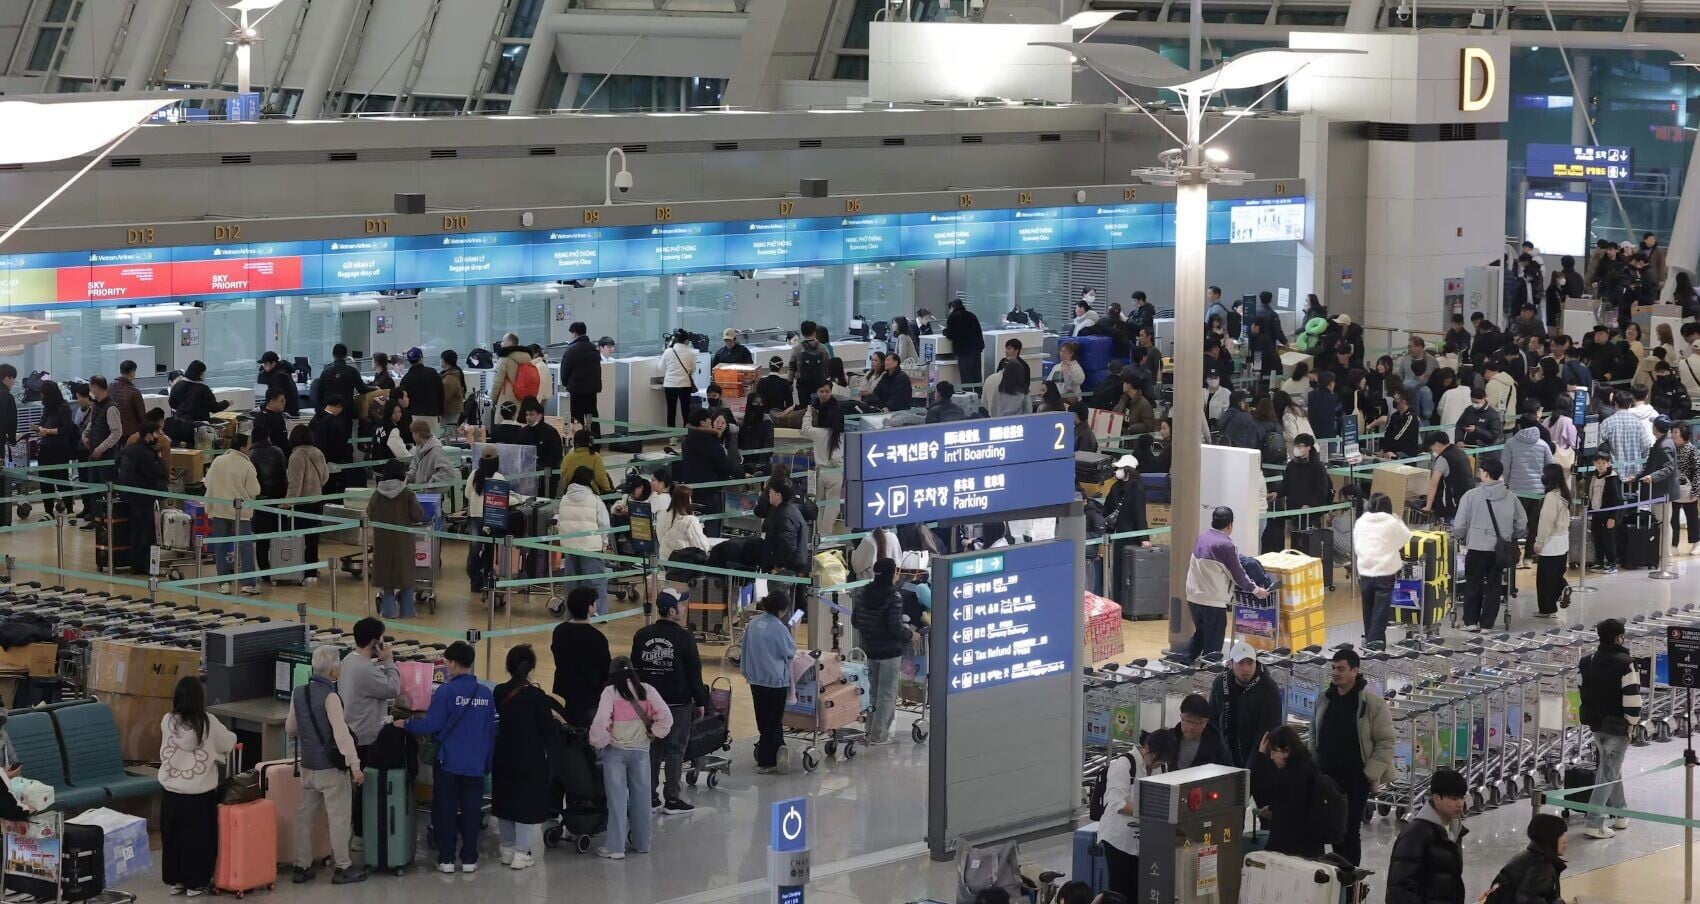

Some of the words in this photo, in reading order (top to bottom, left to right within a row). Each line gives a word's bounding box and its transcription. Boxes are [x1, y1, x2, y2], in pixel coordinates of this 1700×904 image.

[1459, 47, 1496, 111] D
[959, 194, 973, 207] D5
[1019, 192, 1032, 204] D4
[1124, 188, 1137, 200] D3
[779, 202, 795, 215] D7
[846, 199, 861, 212] D6
[583, 210, 600, 224] D9
[655, 207, 672, 221] D8
[365, 219, 390, 233] D11
[443, 215, 468, 231] D10
[127, 228, 154, 245] D13
[214, 224, 241, 241] D12
[88, 281, 105, 289] SKY
[212, 274, 228, 282] SKY
[88, 288, 126, 297] PRIORITY
[212, 281, 249, 290] PRIORITY
[1054, 422, 1065, 450] 2
[886, 440, 940, 464] 국제선탑승
[944, 448, 962, 463] Int'l
[964, 444, 1006, 461] Boarding
[913, 486, 949, 509] 주차장
[953, 494, 988, 510] Parking
[974, 650, 987, 661] Tax
[987, 644, 1012, 658] Refund
[455, 695, 489, 708] Chapion
